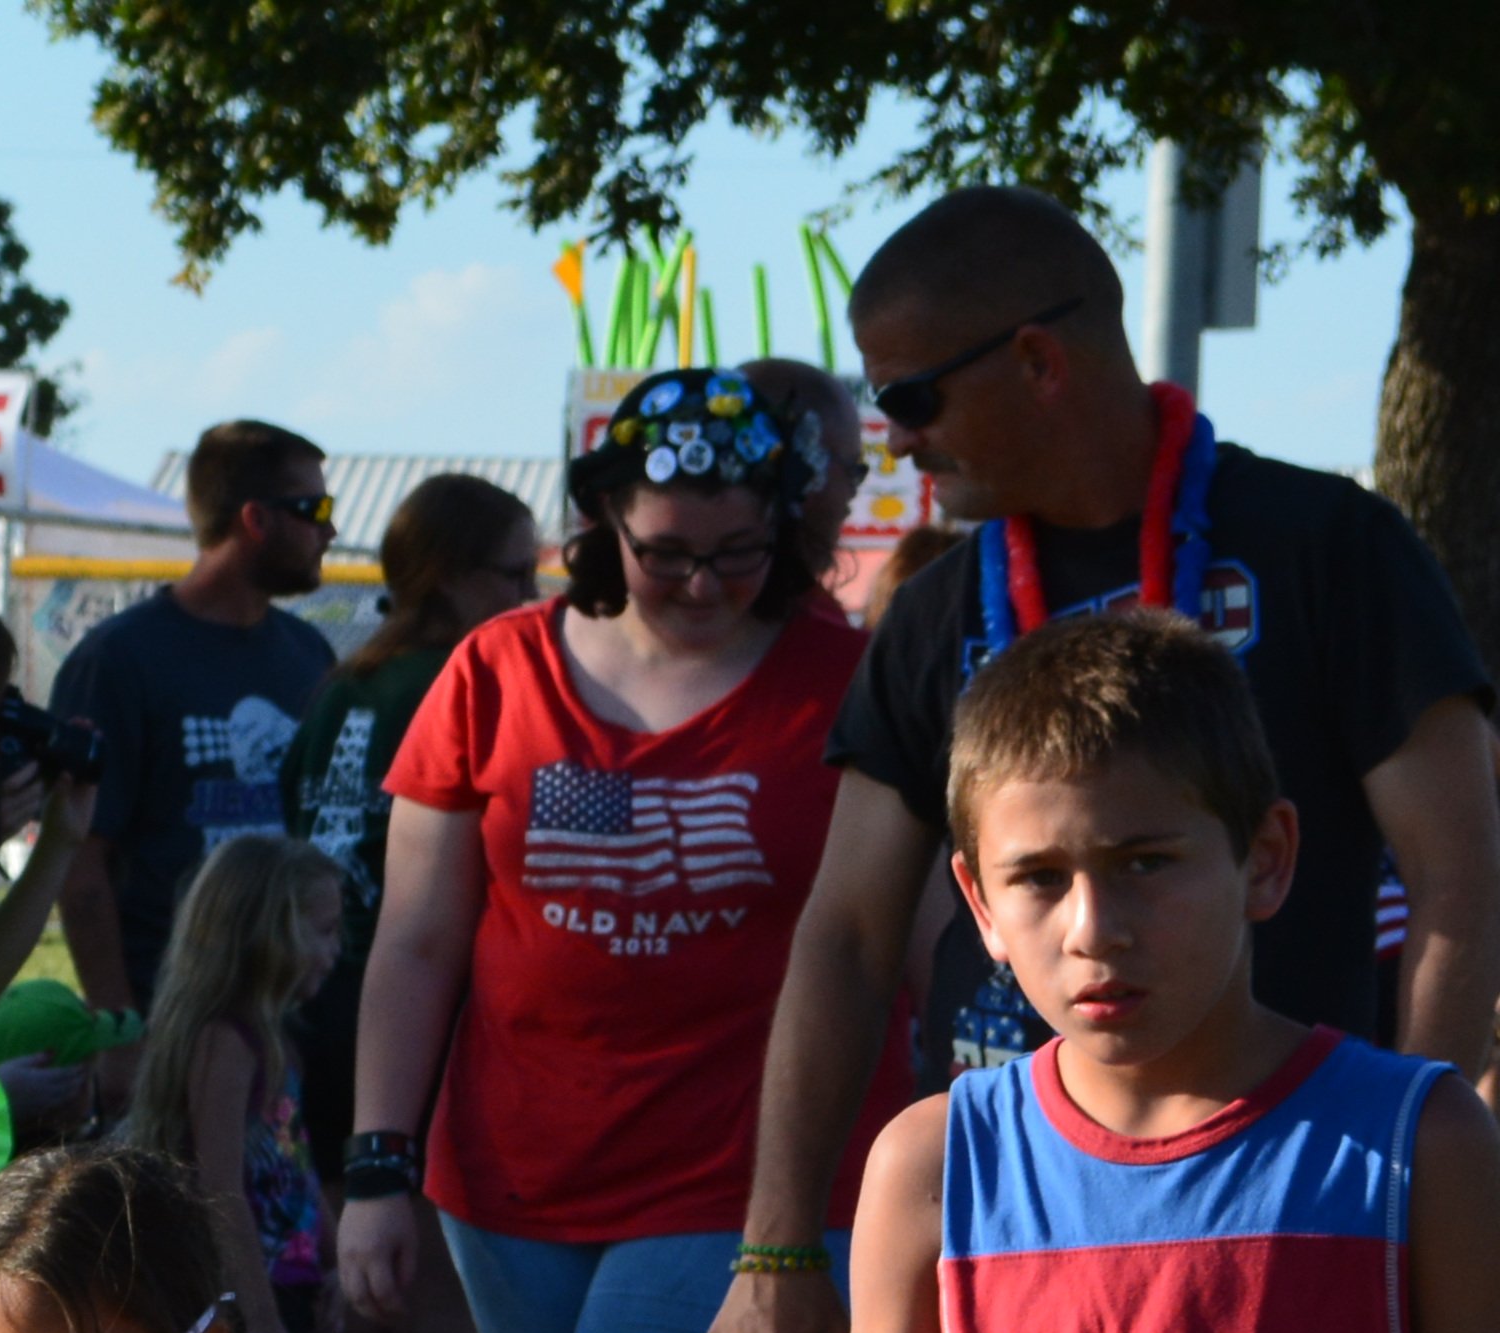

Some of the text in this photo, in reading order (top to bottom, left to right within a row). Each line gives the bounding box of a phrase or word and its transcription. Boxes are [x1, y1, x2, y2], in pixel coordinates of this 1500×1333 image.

[543, 902, 748, 936] OLD NAVY
[609, 937, 670, 956] 2012
